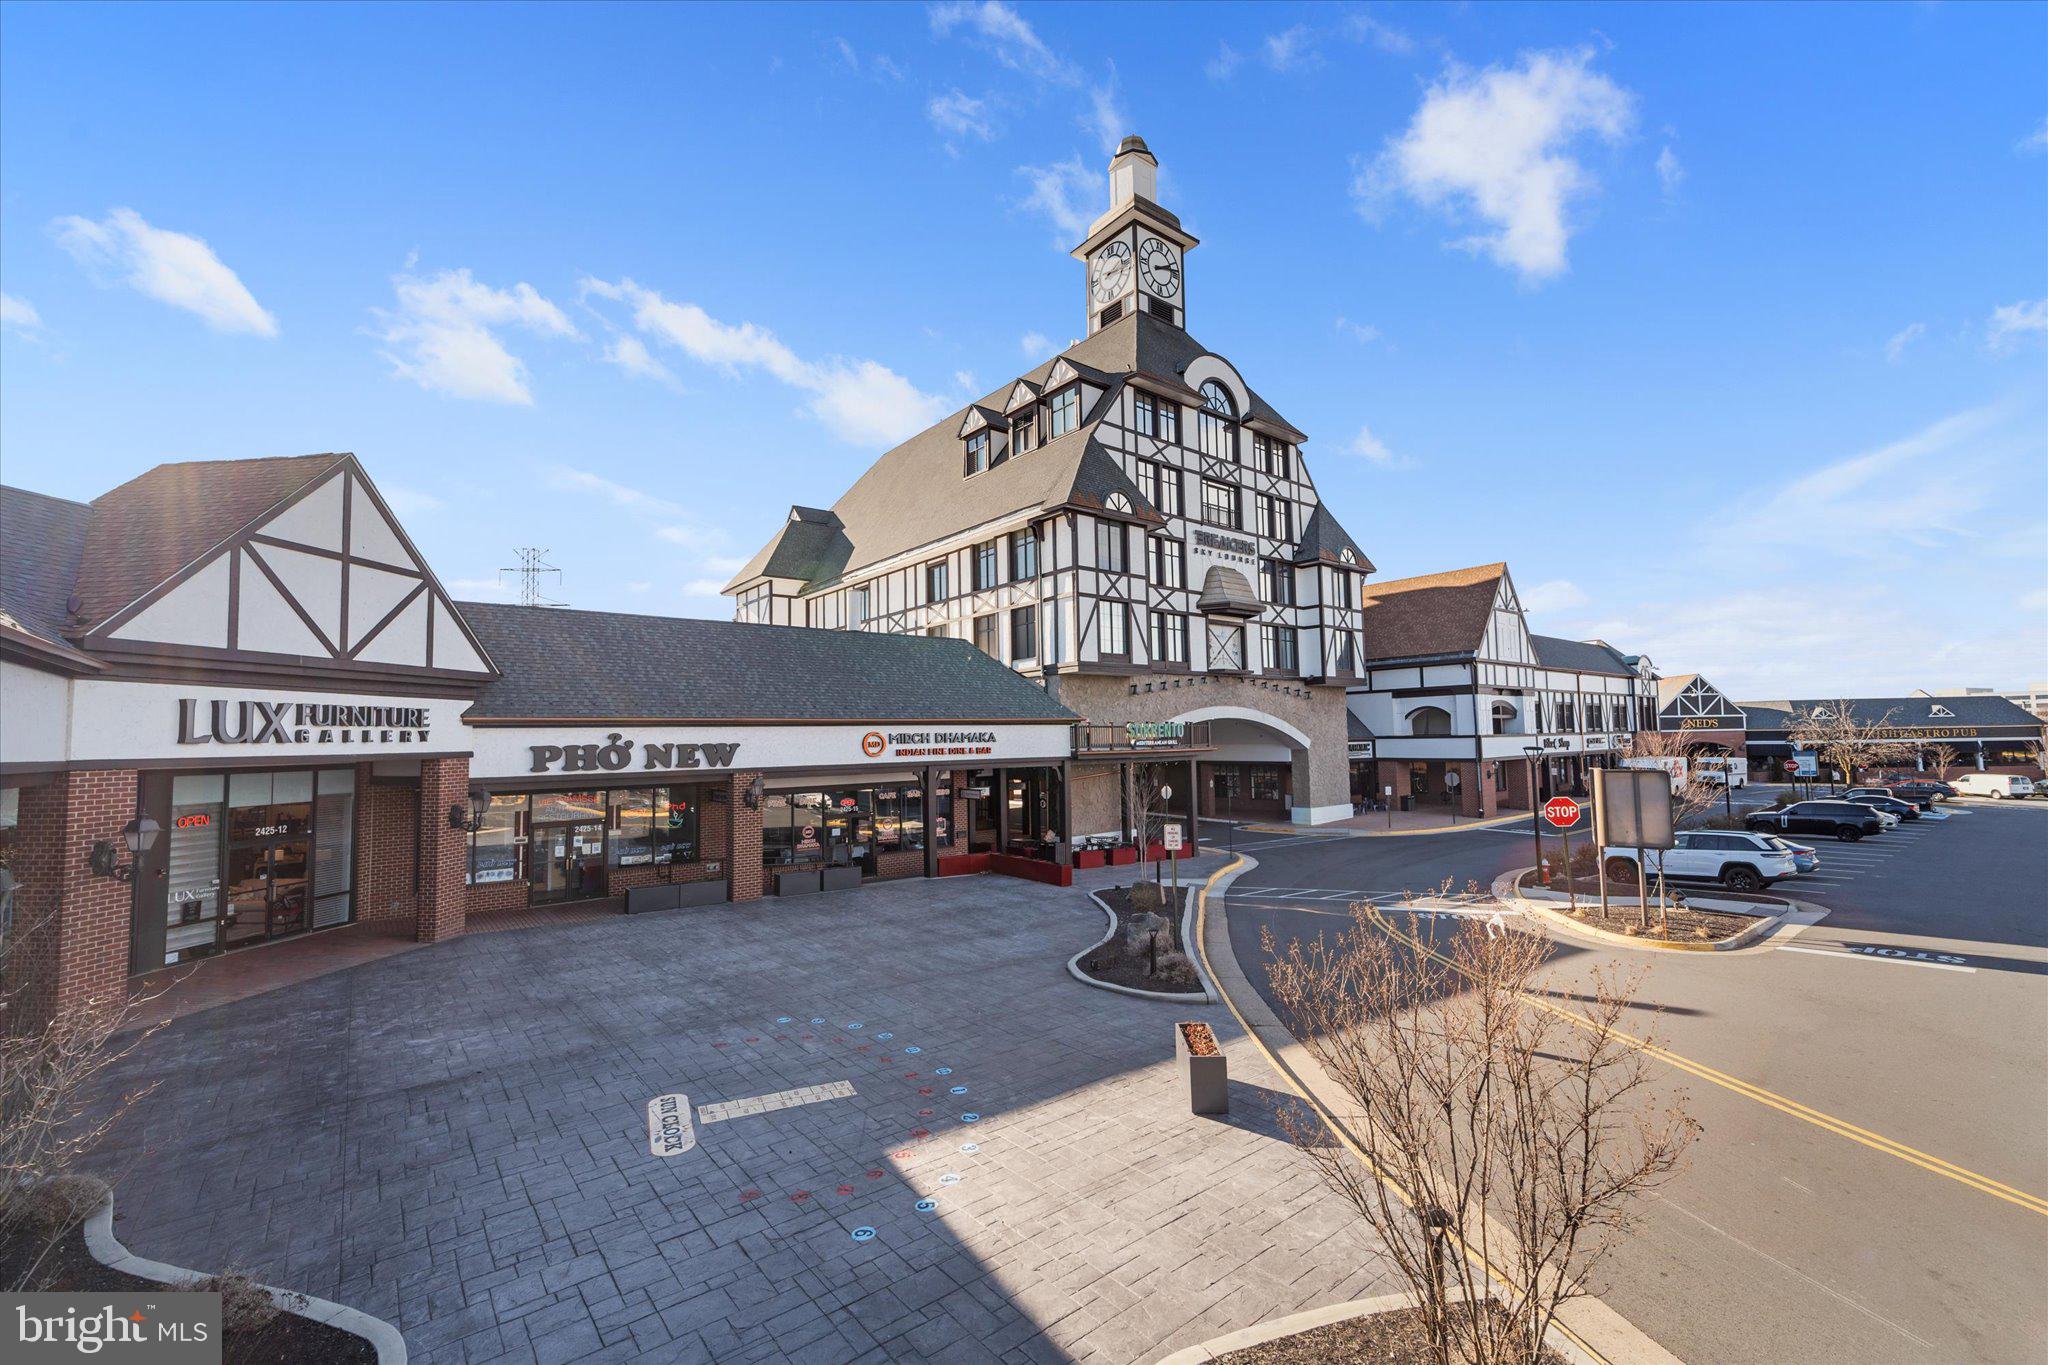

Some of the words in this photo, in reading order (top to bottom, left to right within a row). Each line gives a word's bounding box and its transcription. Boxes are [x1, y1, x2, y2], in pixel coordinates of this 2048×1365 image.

[177, 698, 294, 744] LUX
[294, 703, 431, 728] FURNITURE
[1688, 718, 1718, 728] NED'S
[294, 729, 431, 743] GALLERY
[888, 733, 930, 745] MIRCH
[934, 732, 996, 744] DHAMAKA
[1953, 728, 1978, 737] PUB
[643, 742, 741, 769] NEW
[895, 749, 926, 757] INDIAN
[1547, 806, 1577, 818] STOP
[177, 815, 210, 828] OPEN
[255, 825, 288, 836] 2425-12
[168, 889, 195, 903] LUX
[1850, 946, 1967, 965] STOP
[660, 1096, 676, 1114] SUN
[661, 1115, 682, 1152] CLOCK
